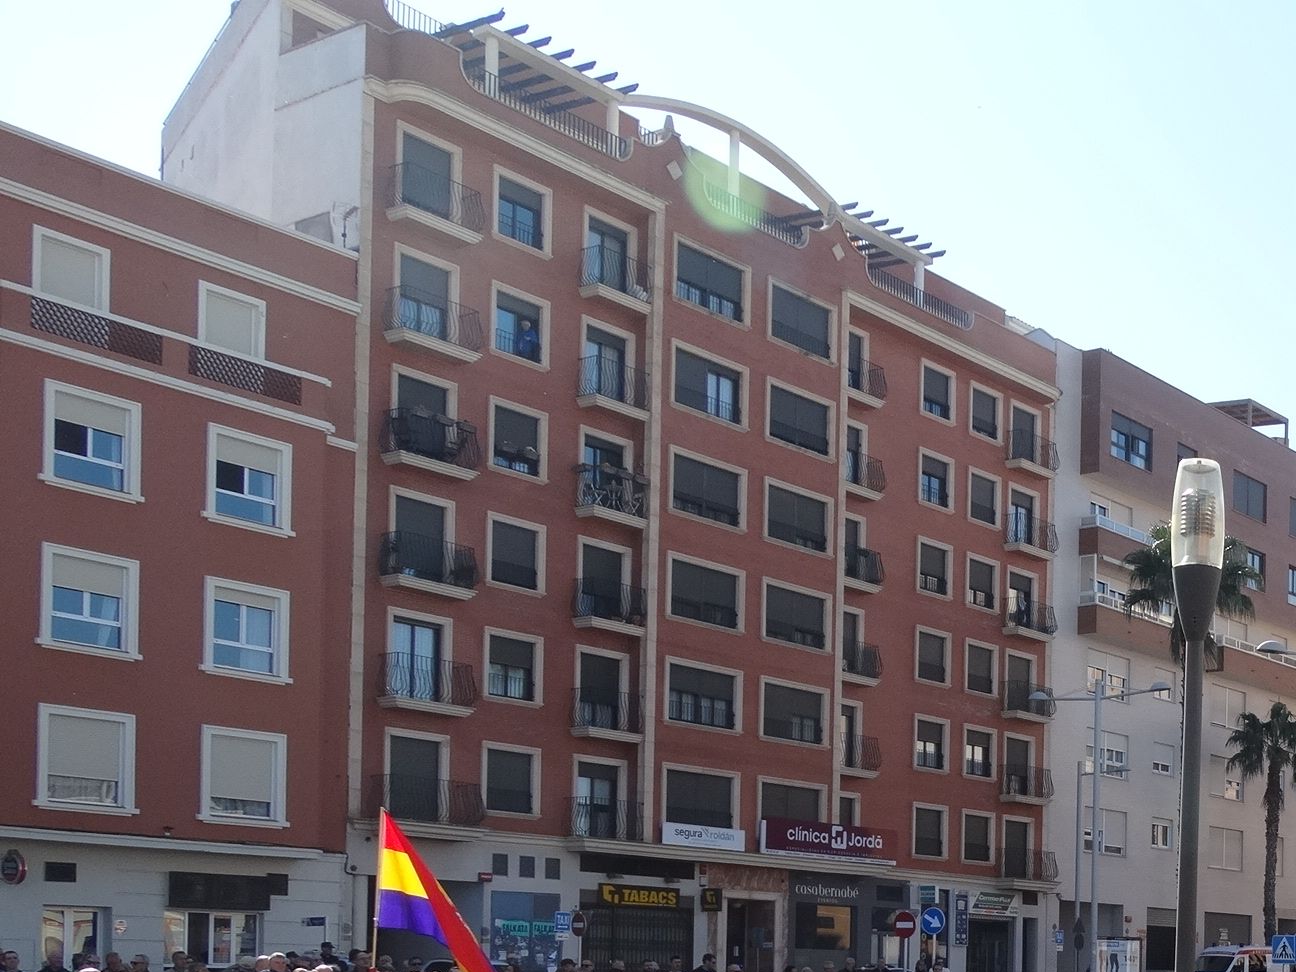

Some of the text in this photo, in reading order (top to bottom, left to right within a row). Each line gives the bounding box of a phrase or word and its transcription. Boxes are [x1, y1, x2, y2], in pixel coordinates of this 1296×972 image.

[674, 828, 703, 840] segura
[786, 825, 829, 844] clínica
[622, 889, 677, 905] TABACS
